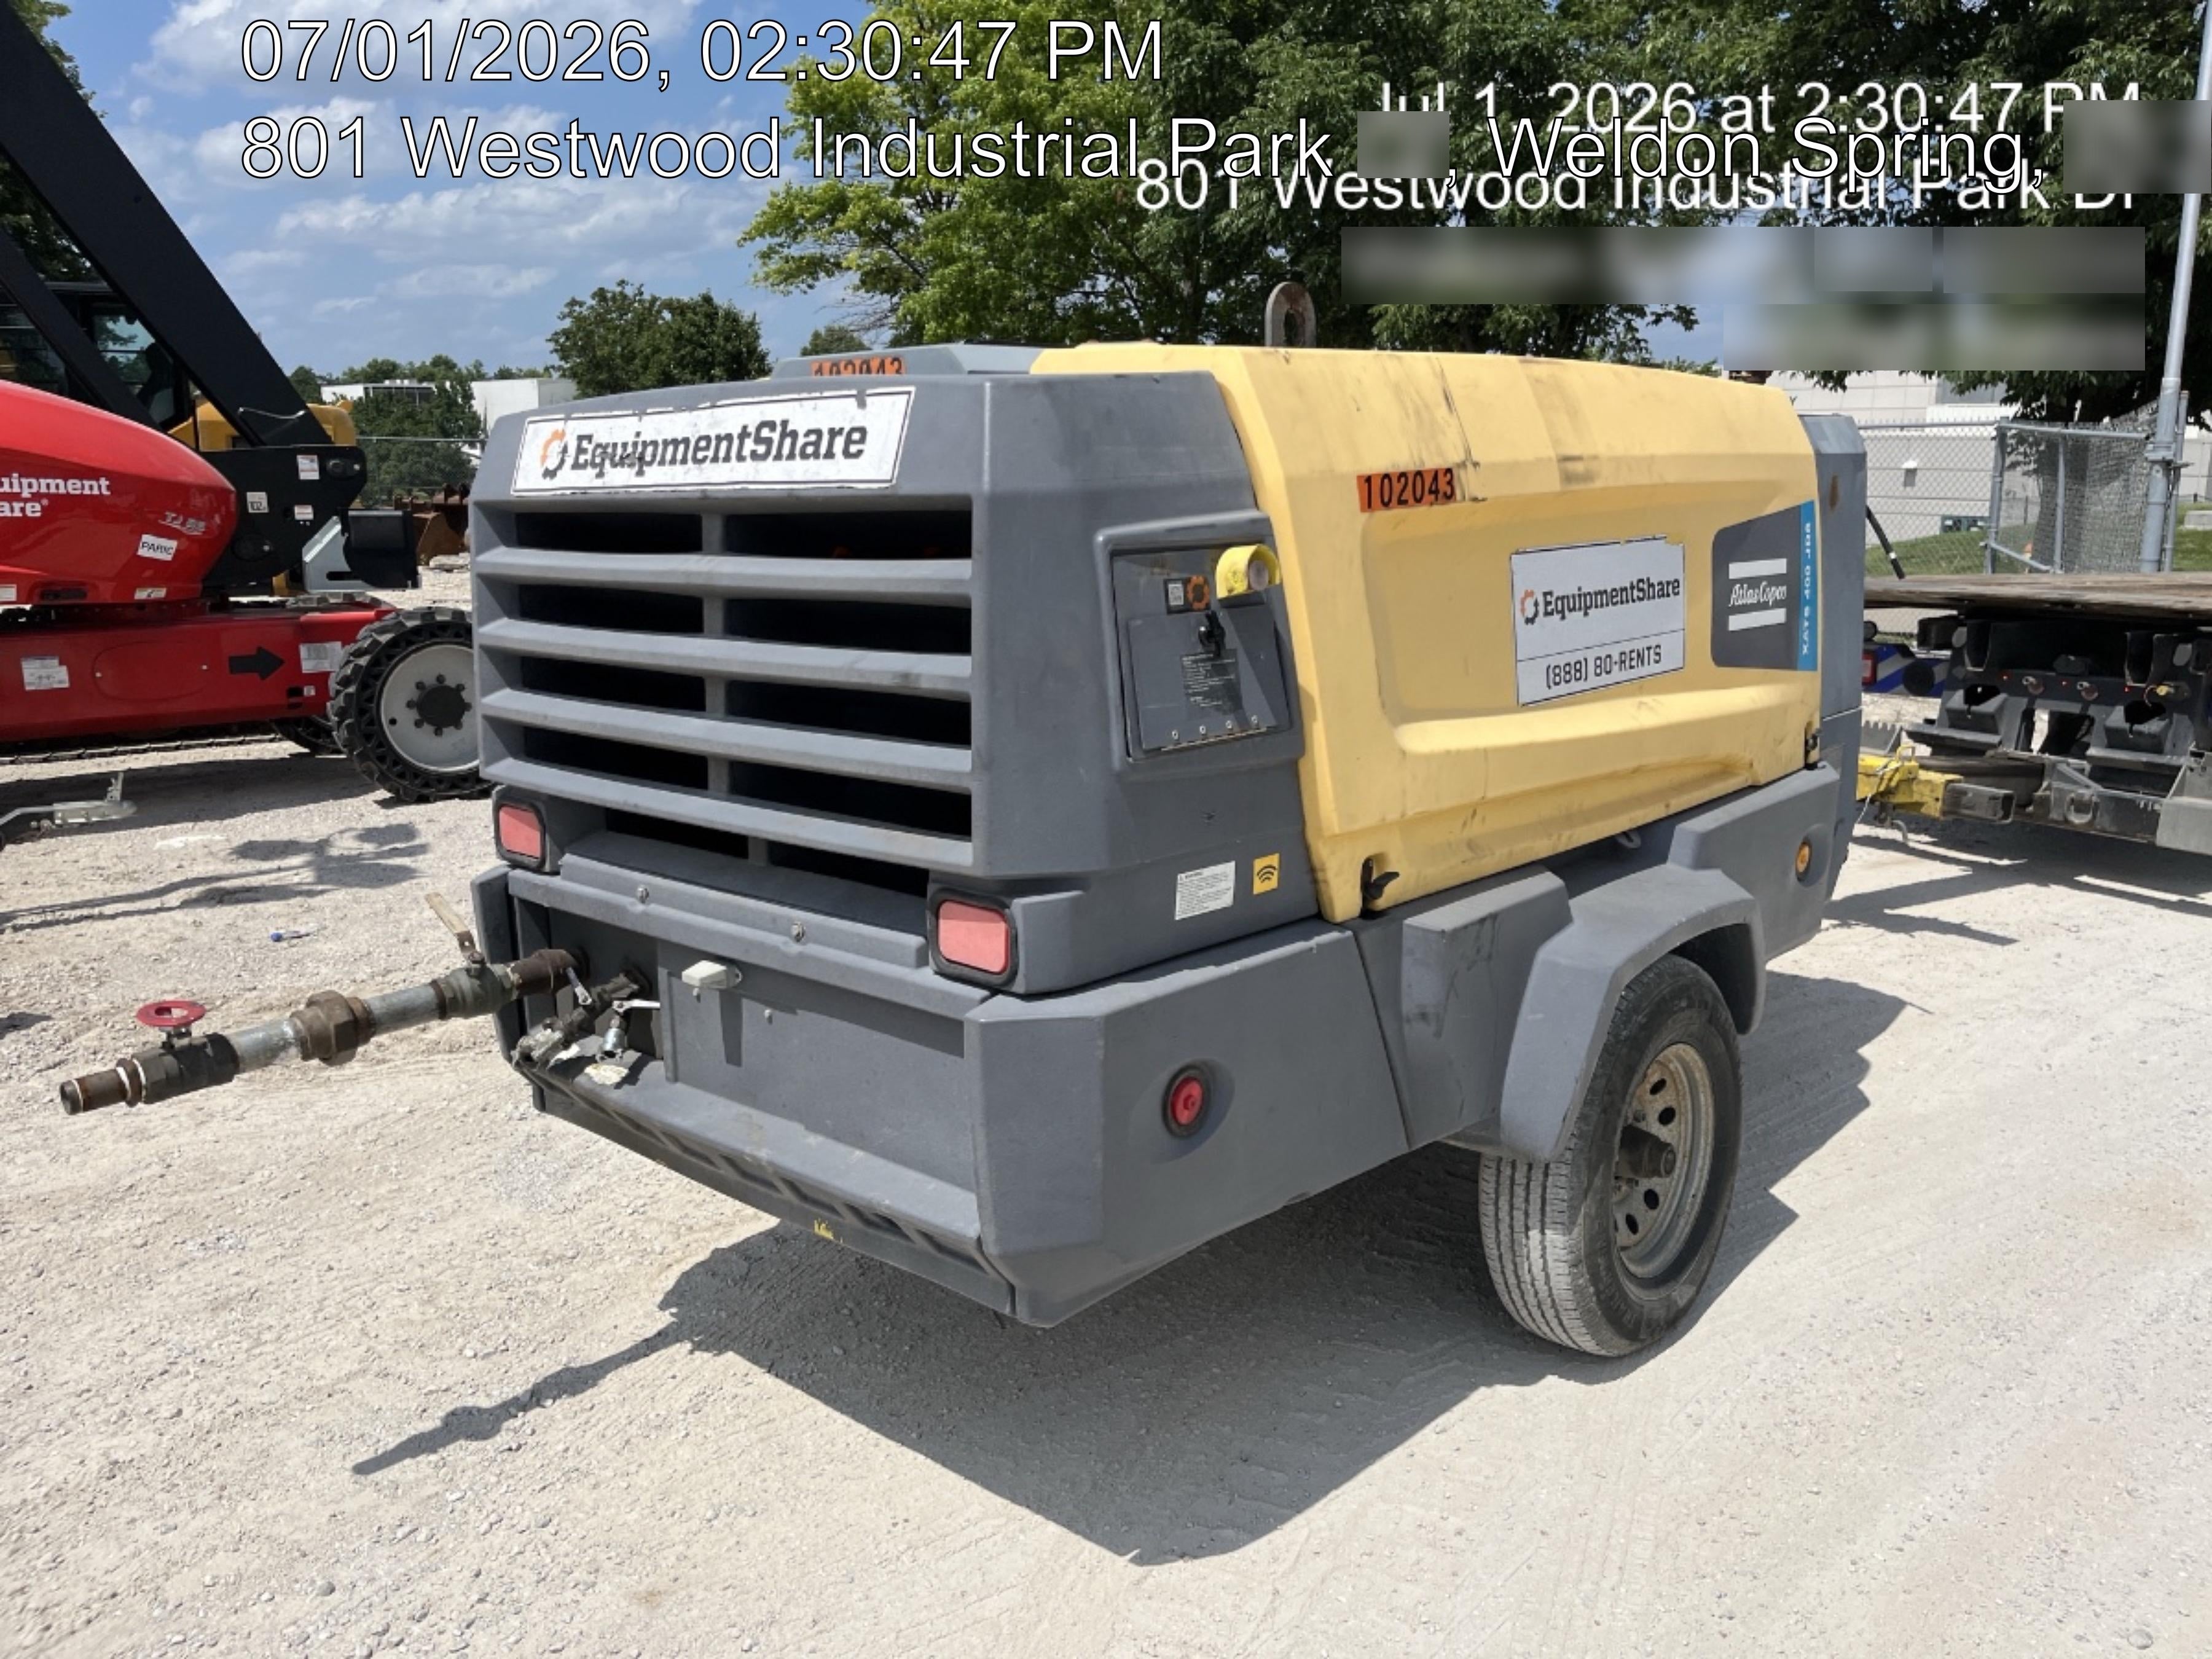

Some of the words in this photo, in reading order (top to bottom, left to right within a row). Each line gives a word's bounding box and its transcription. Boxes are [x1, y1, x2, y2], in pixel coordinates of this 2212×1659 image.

[571, 420, 867, 477] EquipmentShare
[1363, 467, 1456, 509] 102043
[1542, 577, 1681, 621] EquipmentShare
[1546, 657, 1588, 689] (888)
